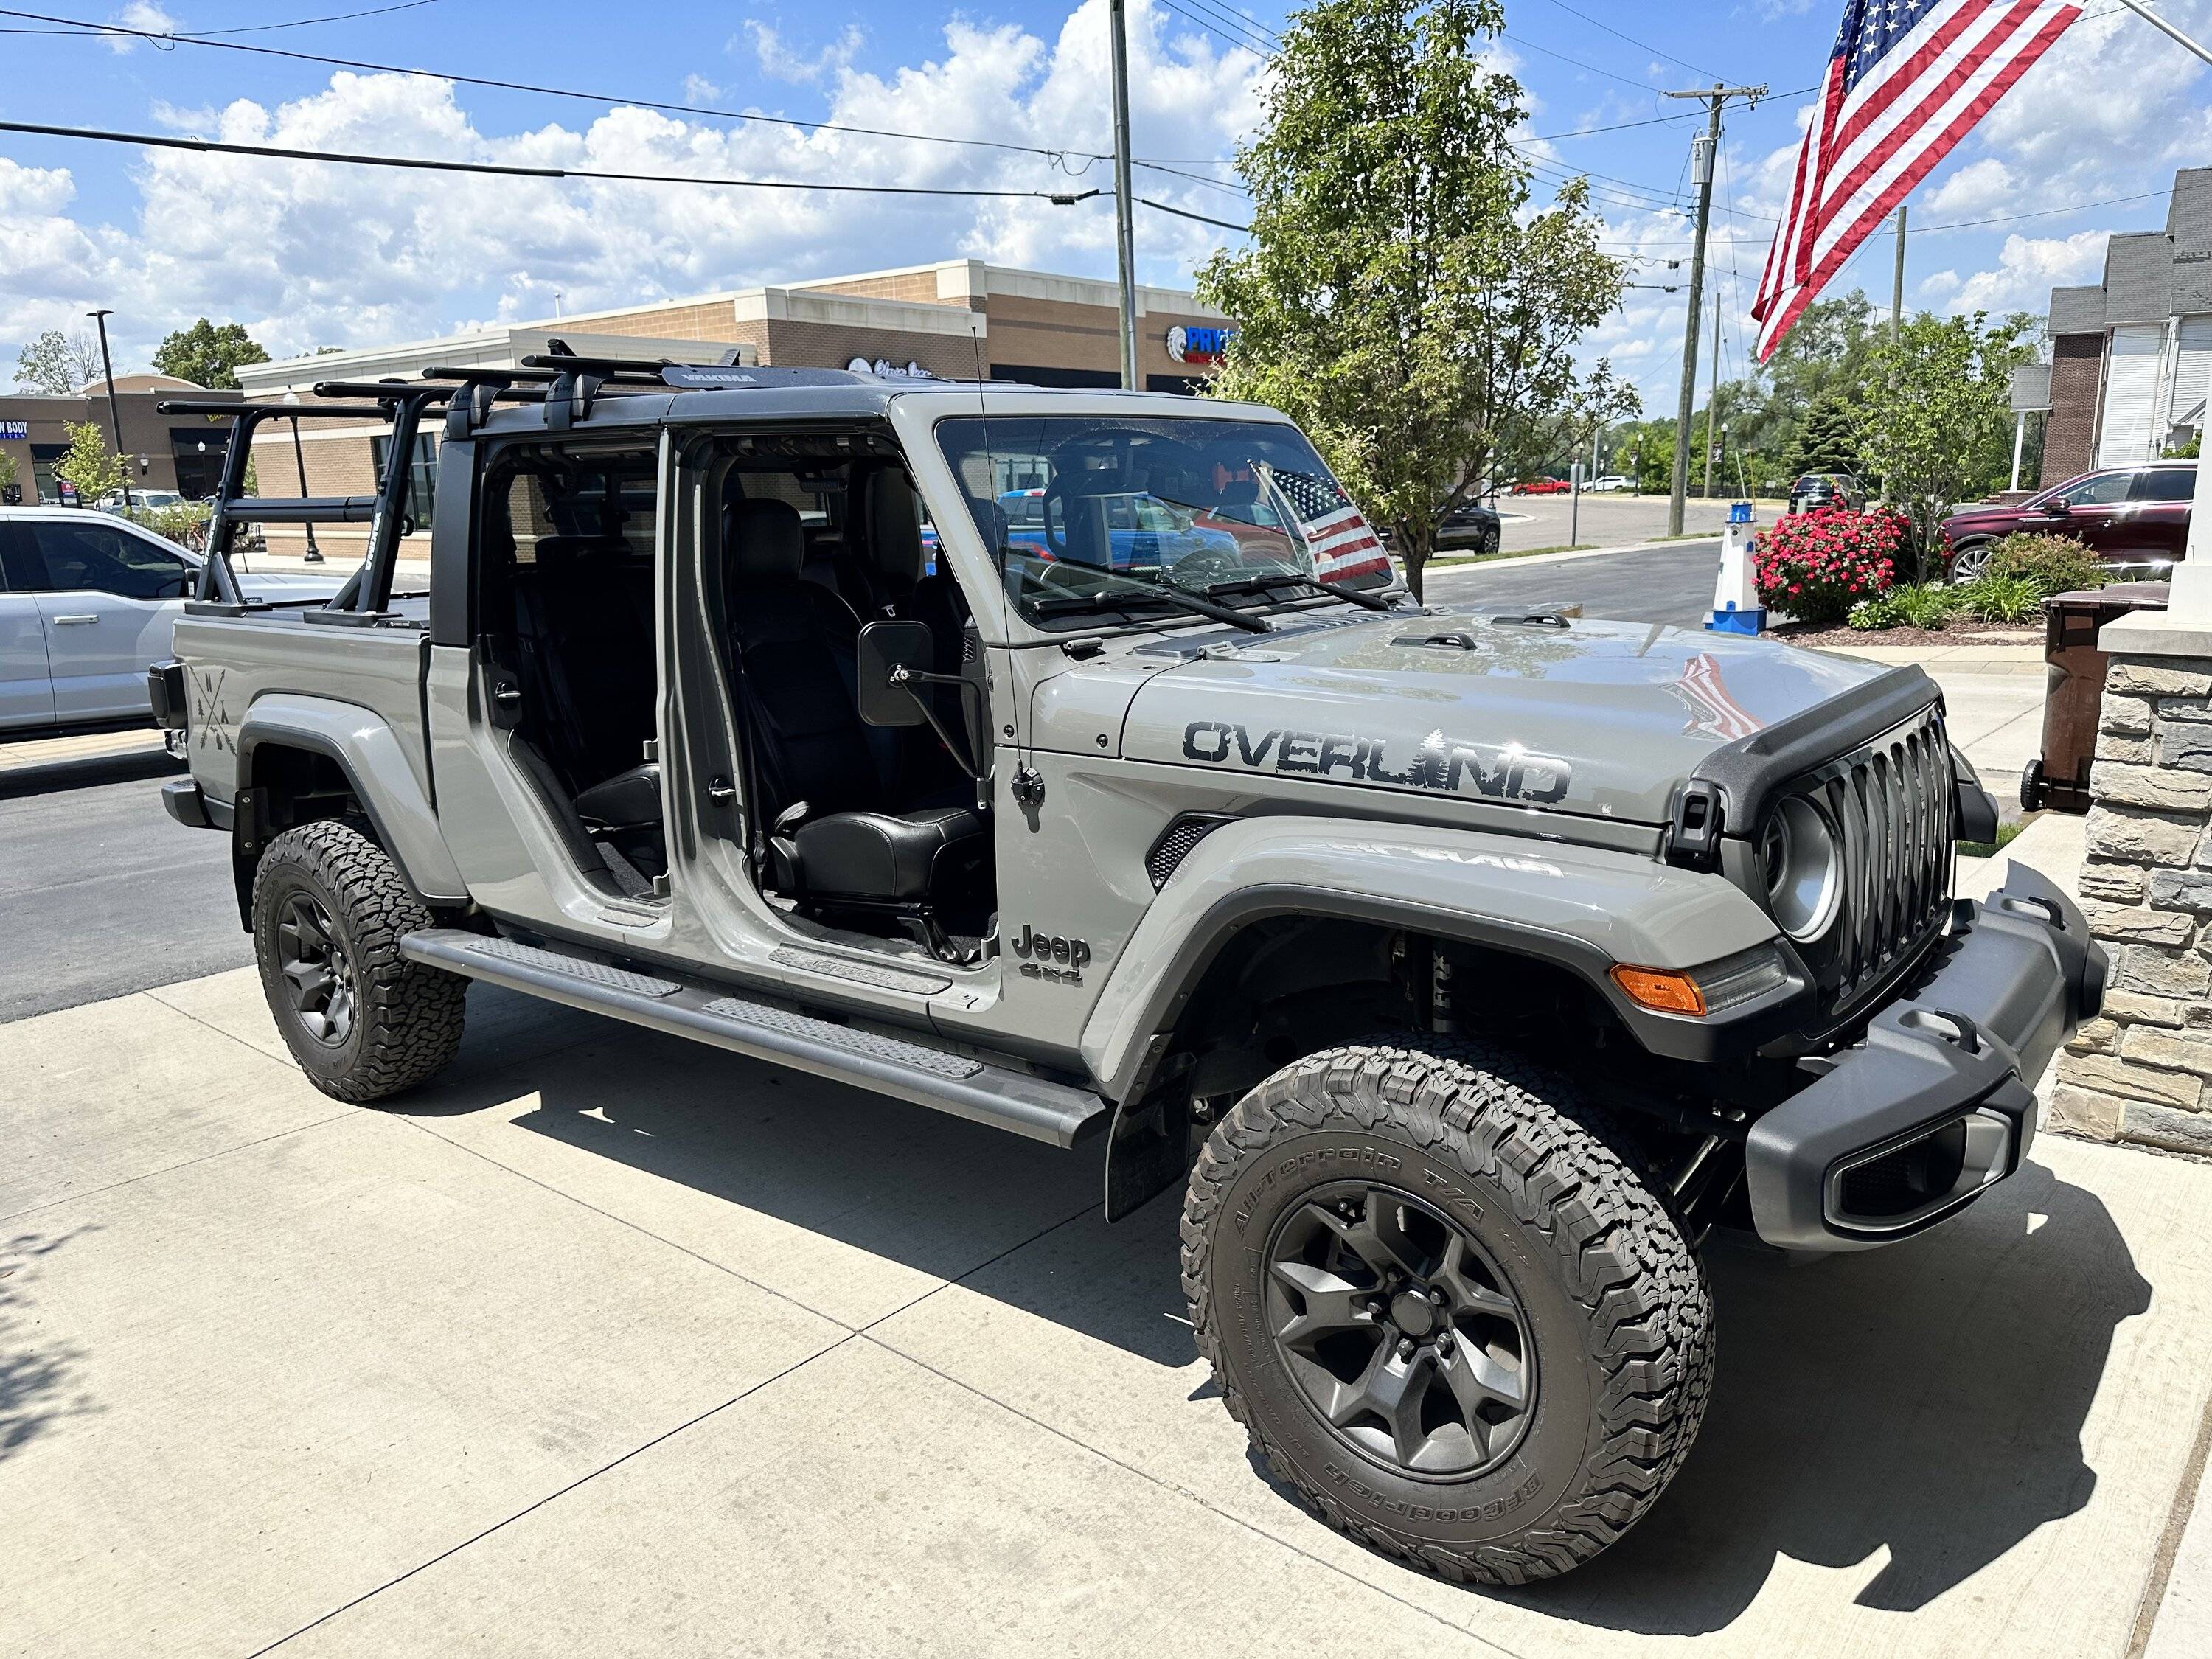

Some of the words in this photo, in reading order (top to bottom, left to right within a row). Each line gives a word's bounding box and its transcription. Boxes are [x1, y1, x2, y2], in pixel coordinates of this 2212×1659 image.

[7, 421, 27, 434] BODY
[1182, 722, 1571, 804] OVERLAND
[1011, 923, 1091, 970] Jeep
[1233, 1147, 1402, 1240] All-Terrain
[1422, 1168, 1484, 1222] T/A
[1324, 1461, 1545, 1524] BFGoodrich
